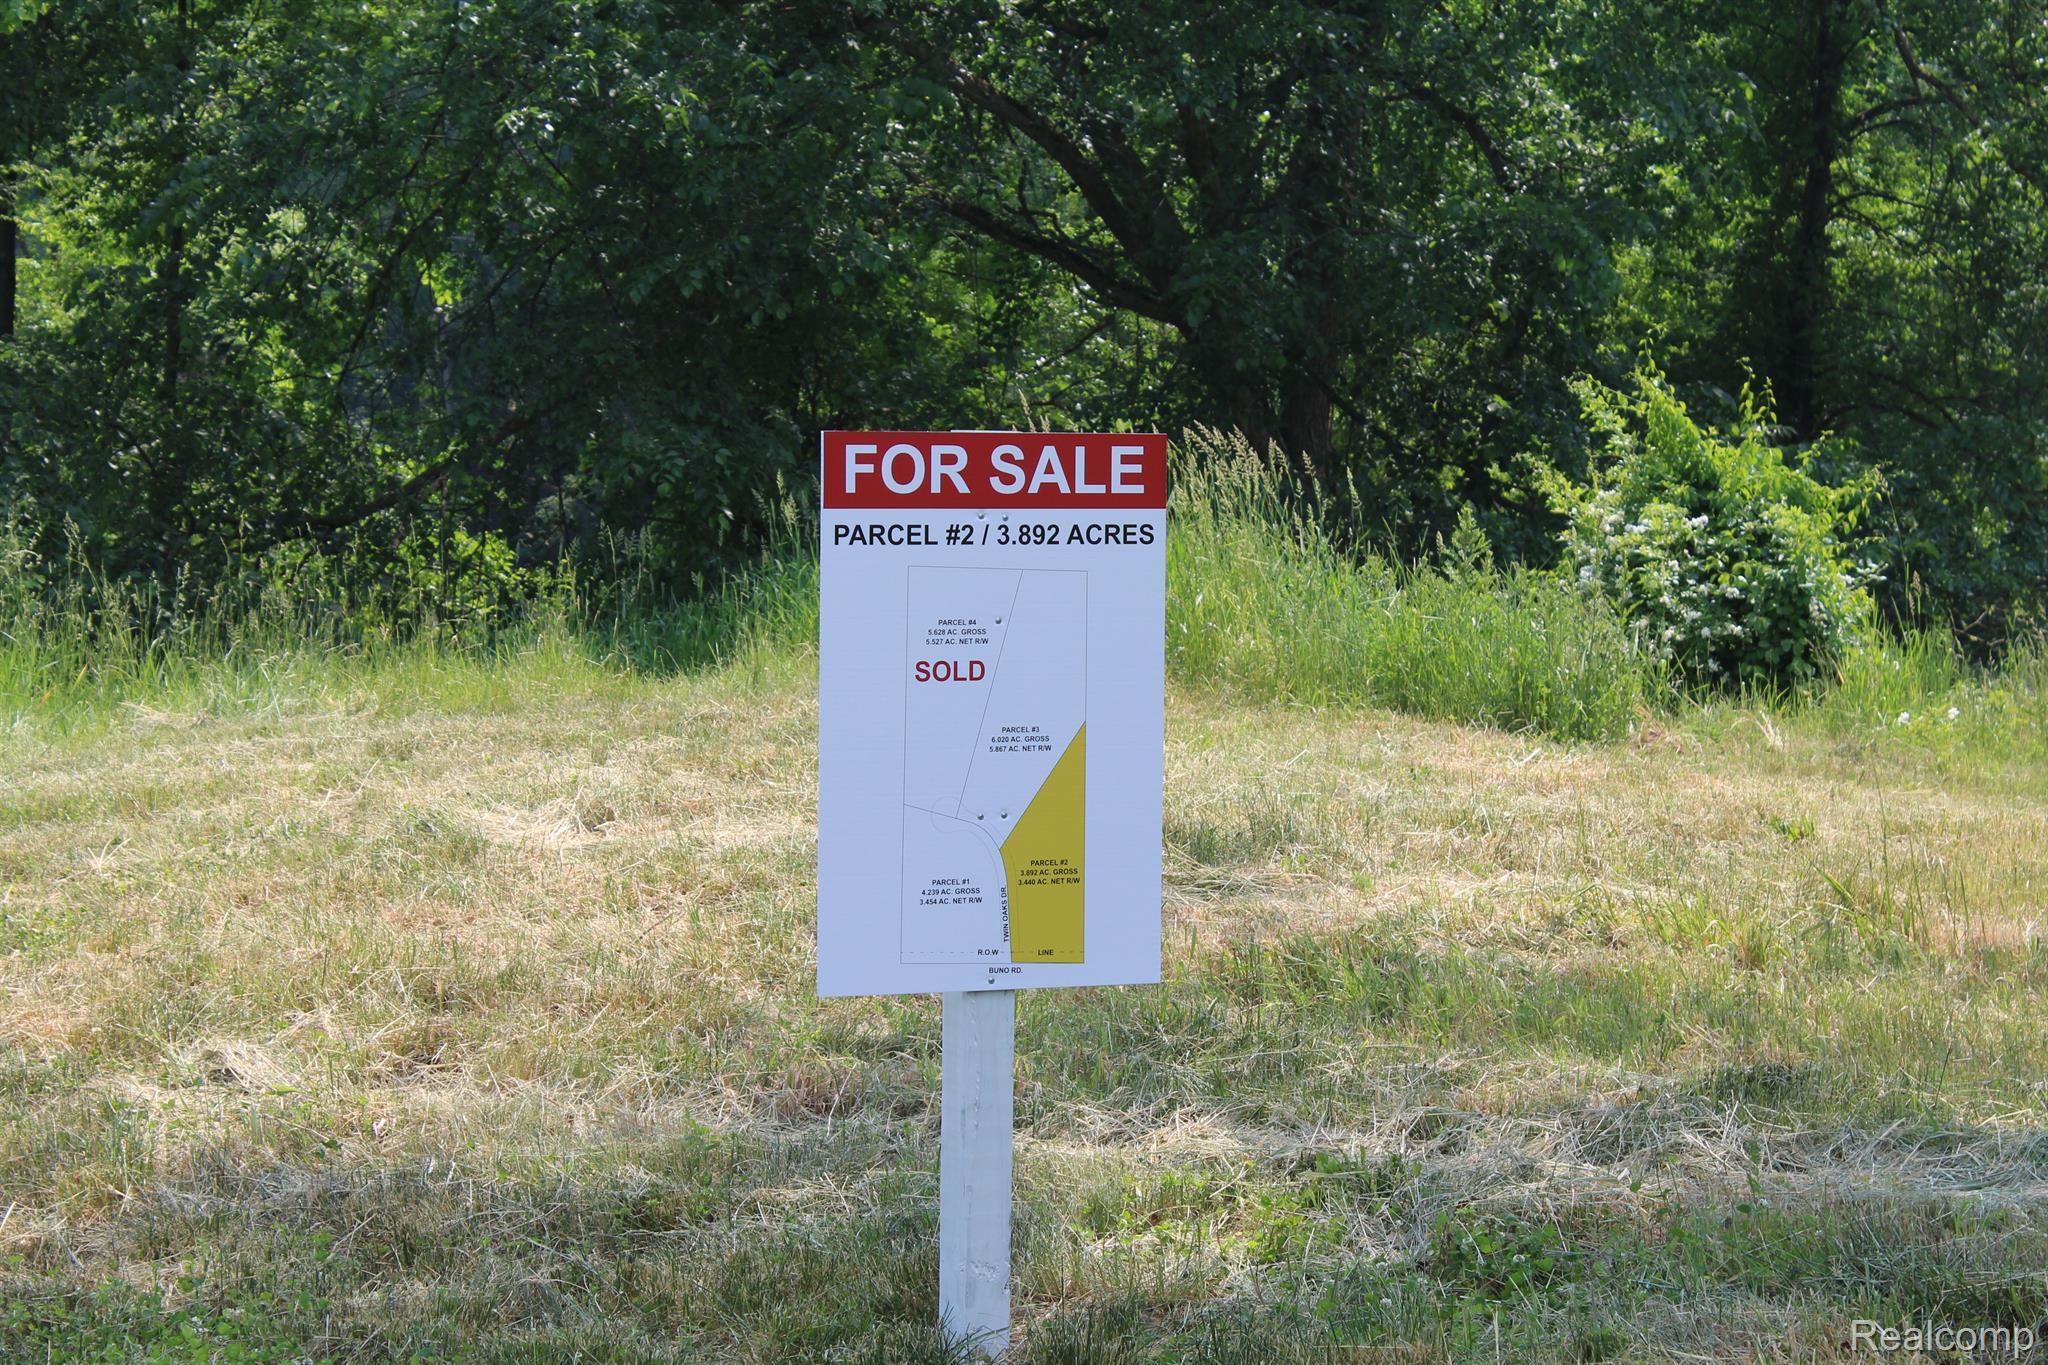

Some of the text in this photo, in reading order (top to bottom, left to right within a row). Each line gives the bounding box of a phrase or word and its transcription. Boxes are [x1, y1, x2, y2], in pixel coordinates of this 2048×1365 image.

[845, 444, 1145, 494] FOR SALE
[834, 524, 1155, 545] PARCEL #2 / 3.892 ACRES
[915, 660, 986, 682] SOLD
[1030, 859, 1058, 867] PARCEL
[921, 888, 940, 896] 4.239
